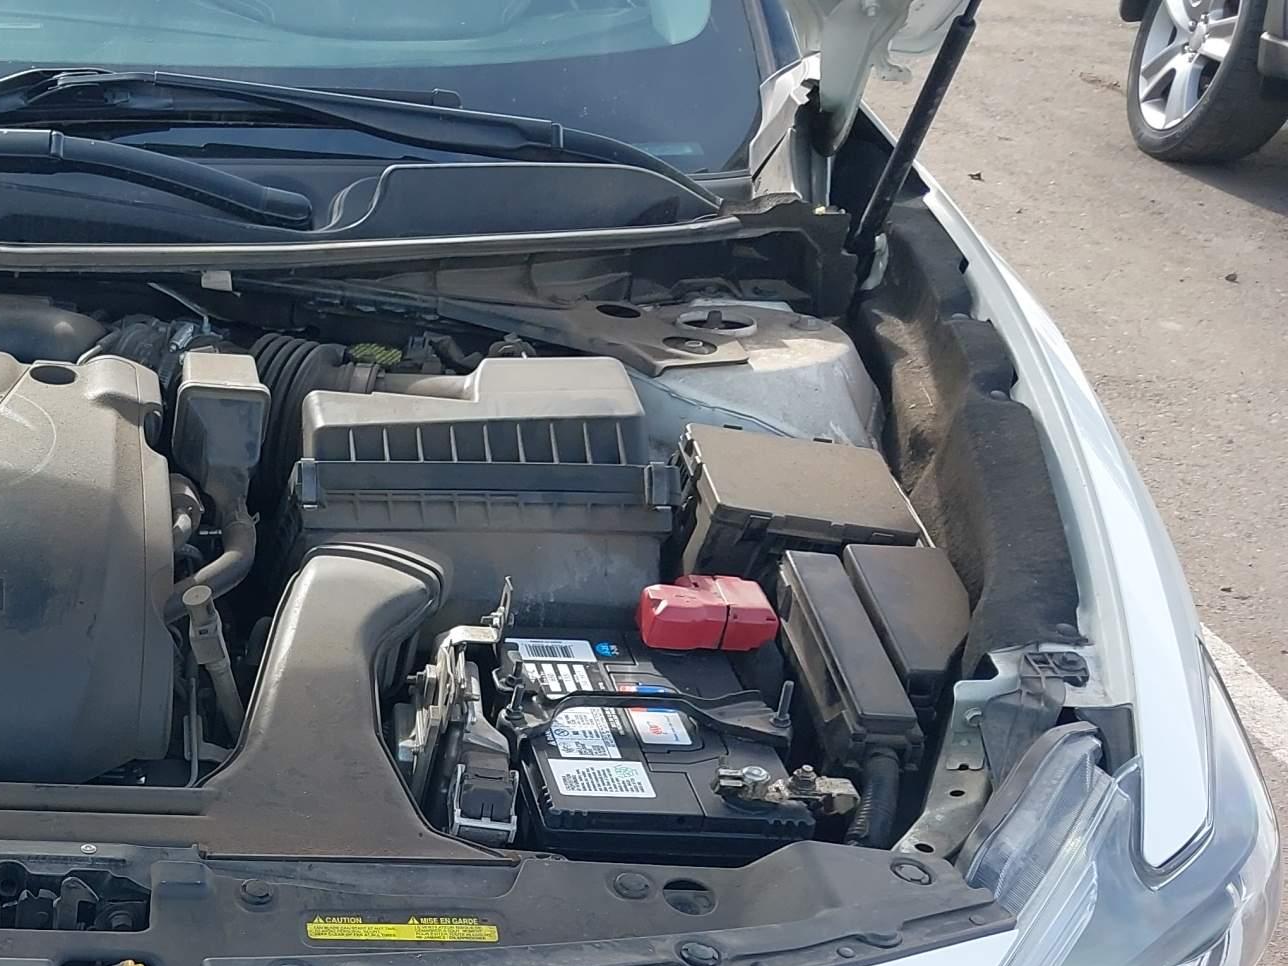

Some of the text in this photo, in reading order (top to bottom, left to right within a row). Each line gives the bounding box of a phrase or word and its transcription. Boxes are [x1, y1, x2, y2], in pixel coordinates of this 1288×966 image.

[325, 916, 363, 924] CAUTION
[420, 917, 479, 925] MISE EN GARDE
